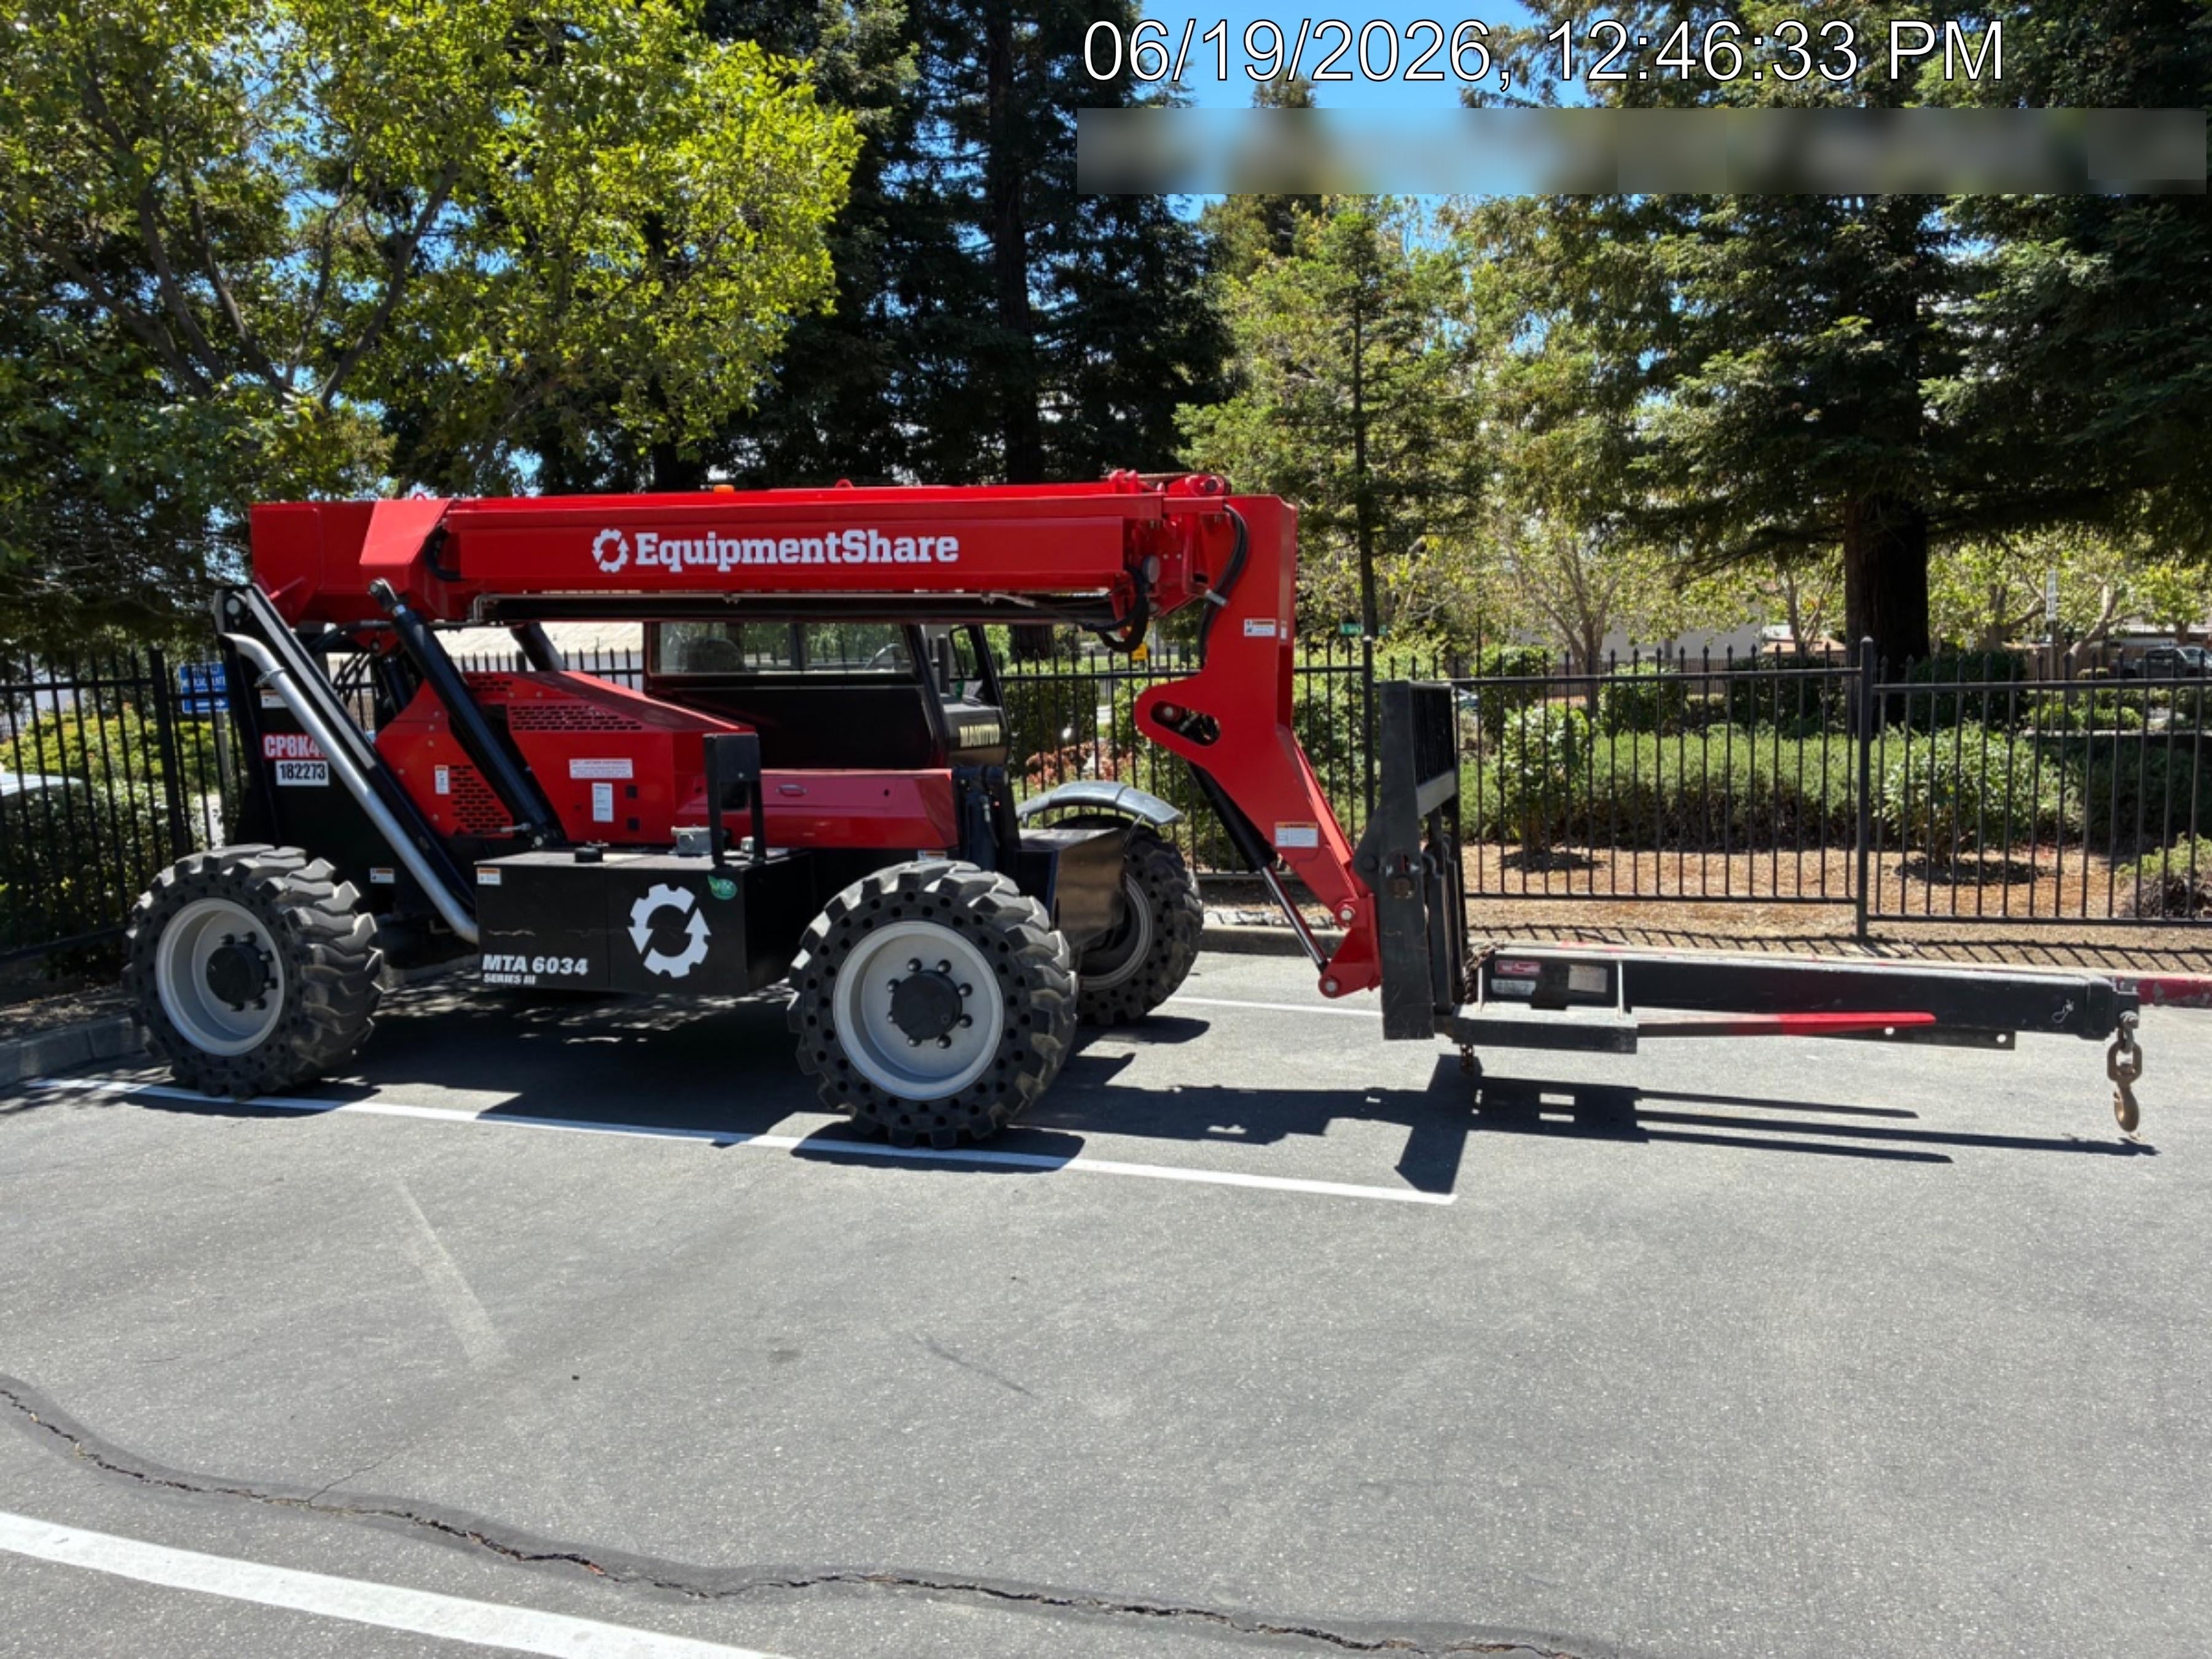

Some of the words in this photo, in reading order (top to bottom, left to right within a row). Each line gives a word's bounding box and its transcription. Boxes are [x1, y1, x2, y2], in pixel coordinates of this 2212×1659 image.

[635, 529, 959, 572] EquipmentShare
[264, 734, 326, 758] CP8K4
[280, 763, 325, 780] 182273
[482, 954, 528, 973] MTA
[532, 955, 588, 975] 6034
[483, 973, 521, 984] SERIES
